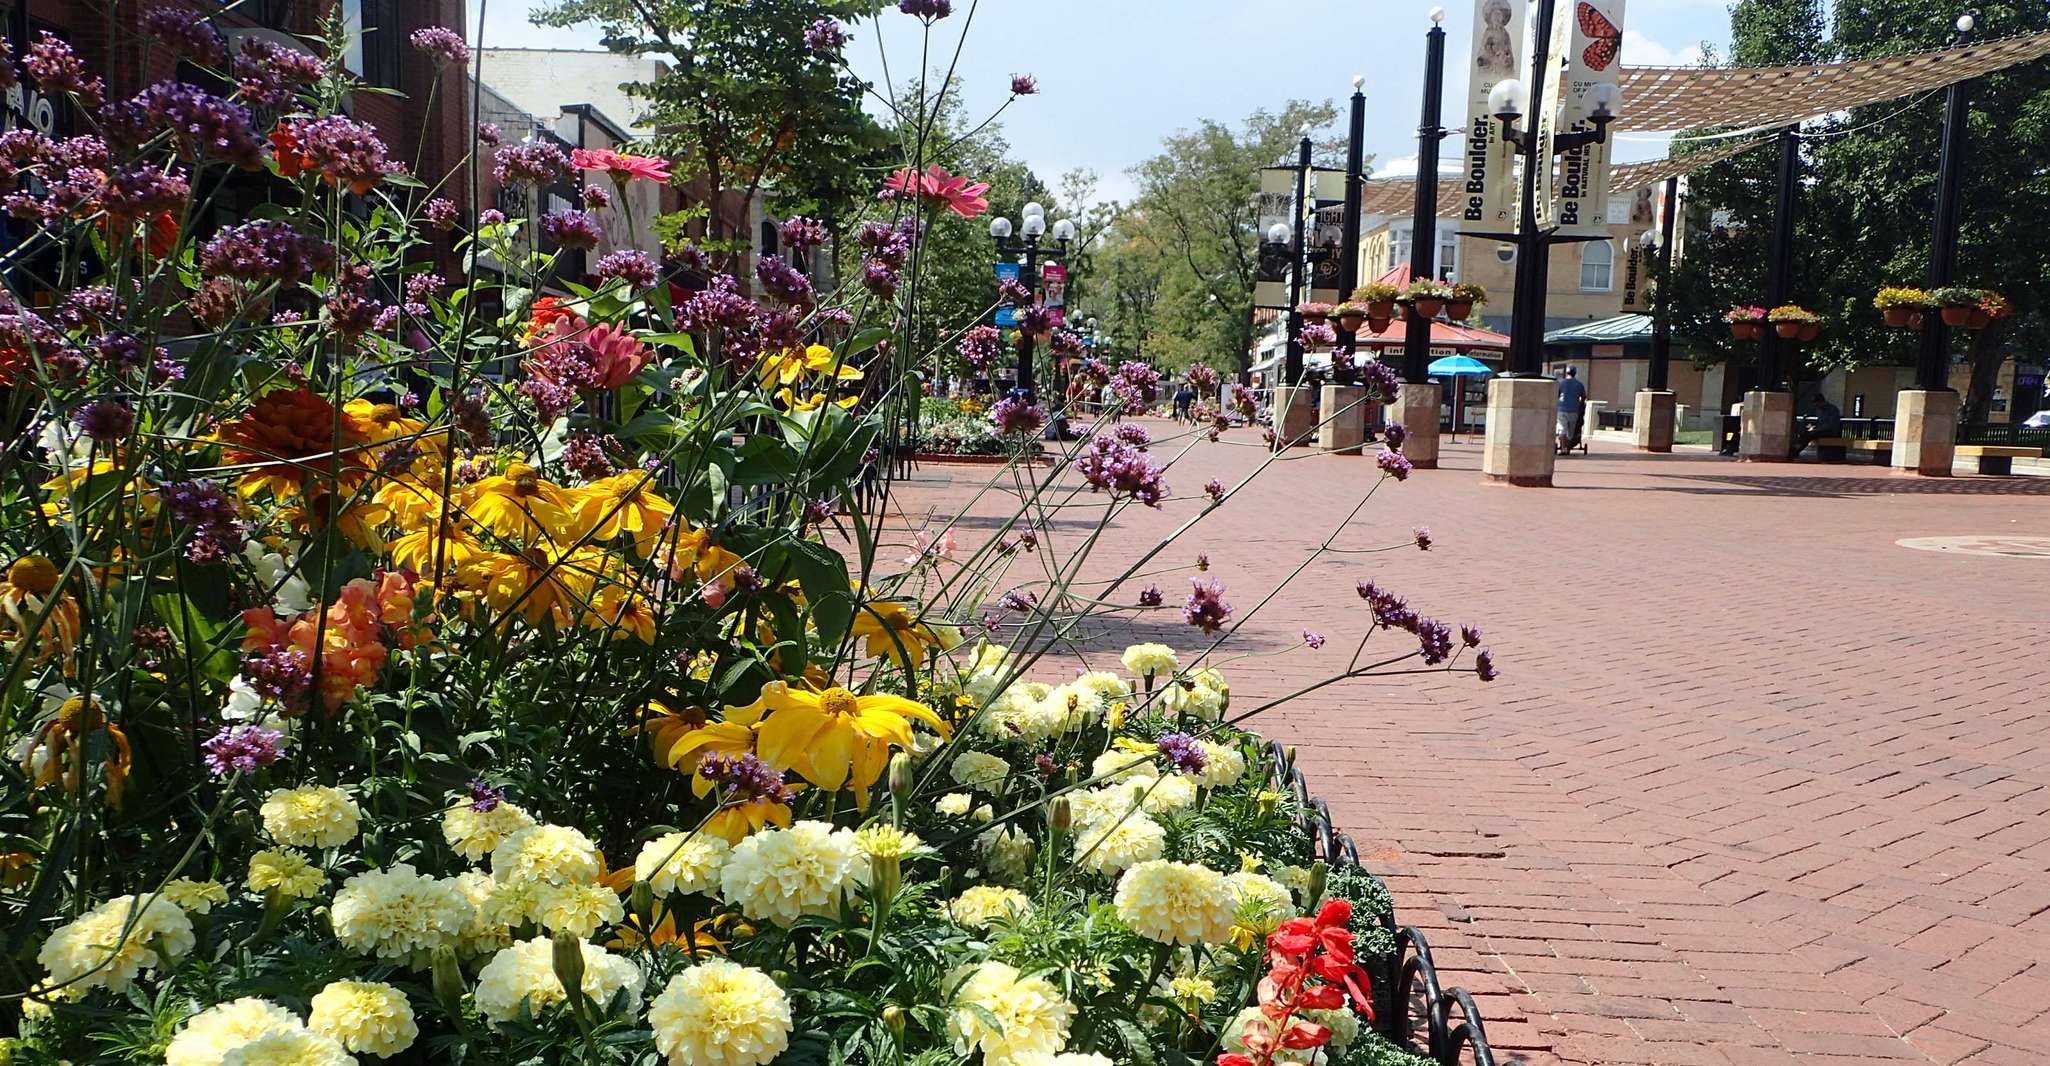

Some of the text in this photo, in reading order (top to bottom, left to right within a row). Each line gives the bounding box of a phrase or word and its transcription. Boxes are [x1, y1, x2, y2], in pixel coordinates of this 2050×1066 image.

[1466, 114, 1489, 193] Boulder.
[1581, 158, 1590, 190] NATURAL
[1464, 196, 1483, 221] Be
[1561, 201, 1578, 225] Be
[1624, 290, 1635, 305] Be
